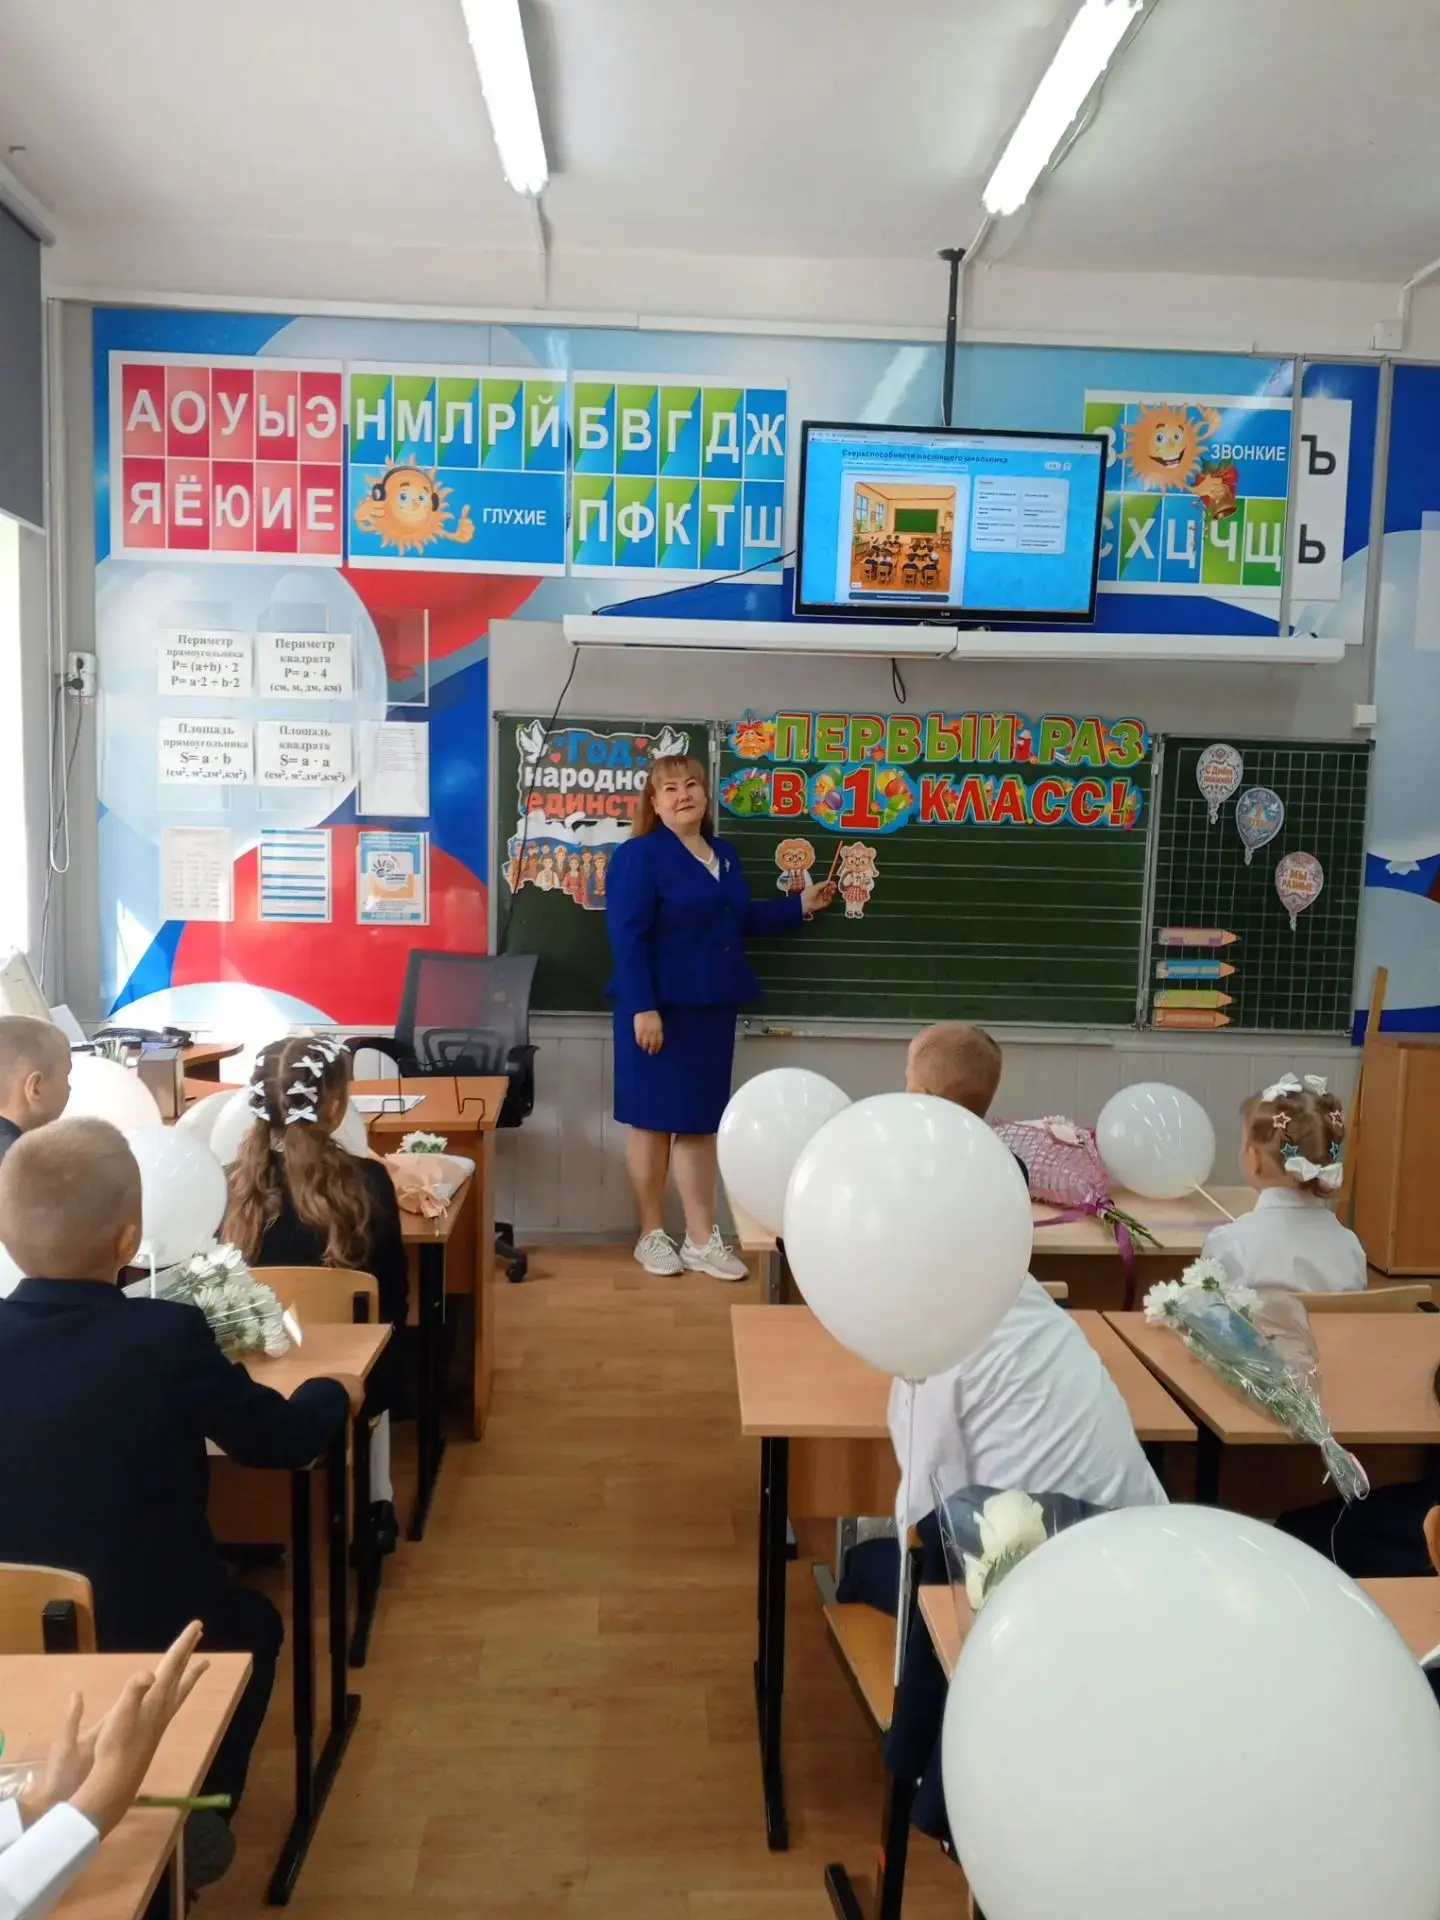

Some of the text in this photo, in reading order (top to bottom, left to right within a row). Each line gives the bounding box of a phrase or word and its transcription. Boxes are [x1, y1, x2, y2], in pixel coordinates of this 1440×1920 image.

[1210, 443, 1286, 462] ЗВОНКИЕ
[1301, 435, 1337, 475] Ъ
[482, 506, 546, 526] ГЛУХИЕ
[1298, 525, 1326, 564] Ь
[178, 634, 233, 648] Периметр
[275, 637, 335, 652] Периметр
[280, 655, 331, 666] квадрата
[178, 722, 235, 736] Площадь
[279, 725, 331, 737] Площадь
[163, 739, 249, 750] прямоугольника
[279, 742, 331, 752] квадрата
[567, 732, 632, 768] Год
[1038, 715, 1145, 767] РАЗ
[524, 764, 649, 793] народно
[525, 791, 640, 818] единст
[770, 763, 1129, 830] В 1 КЛАСС!
